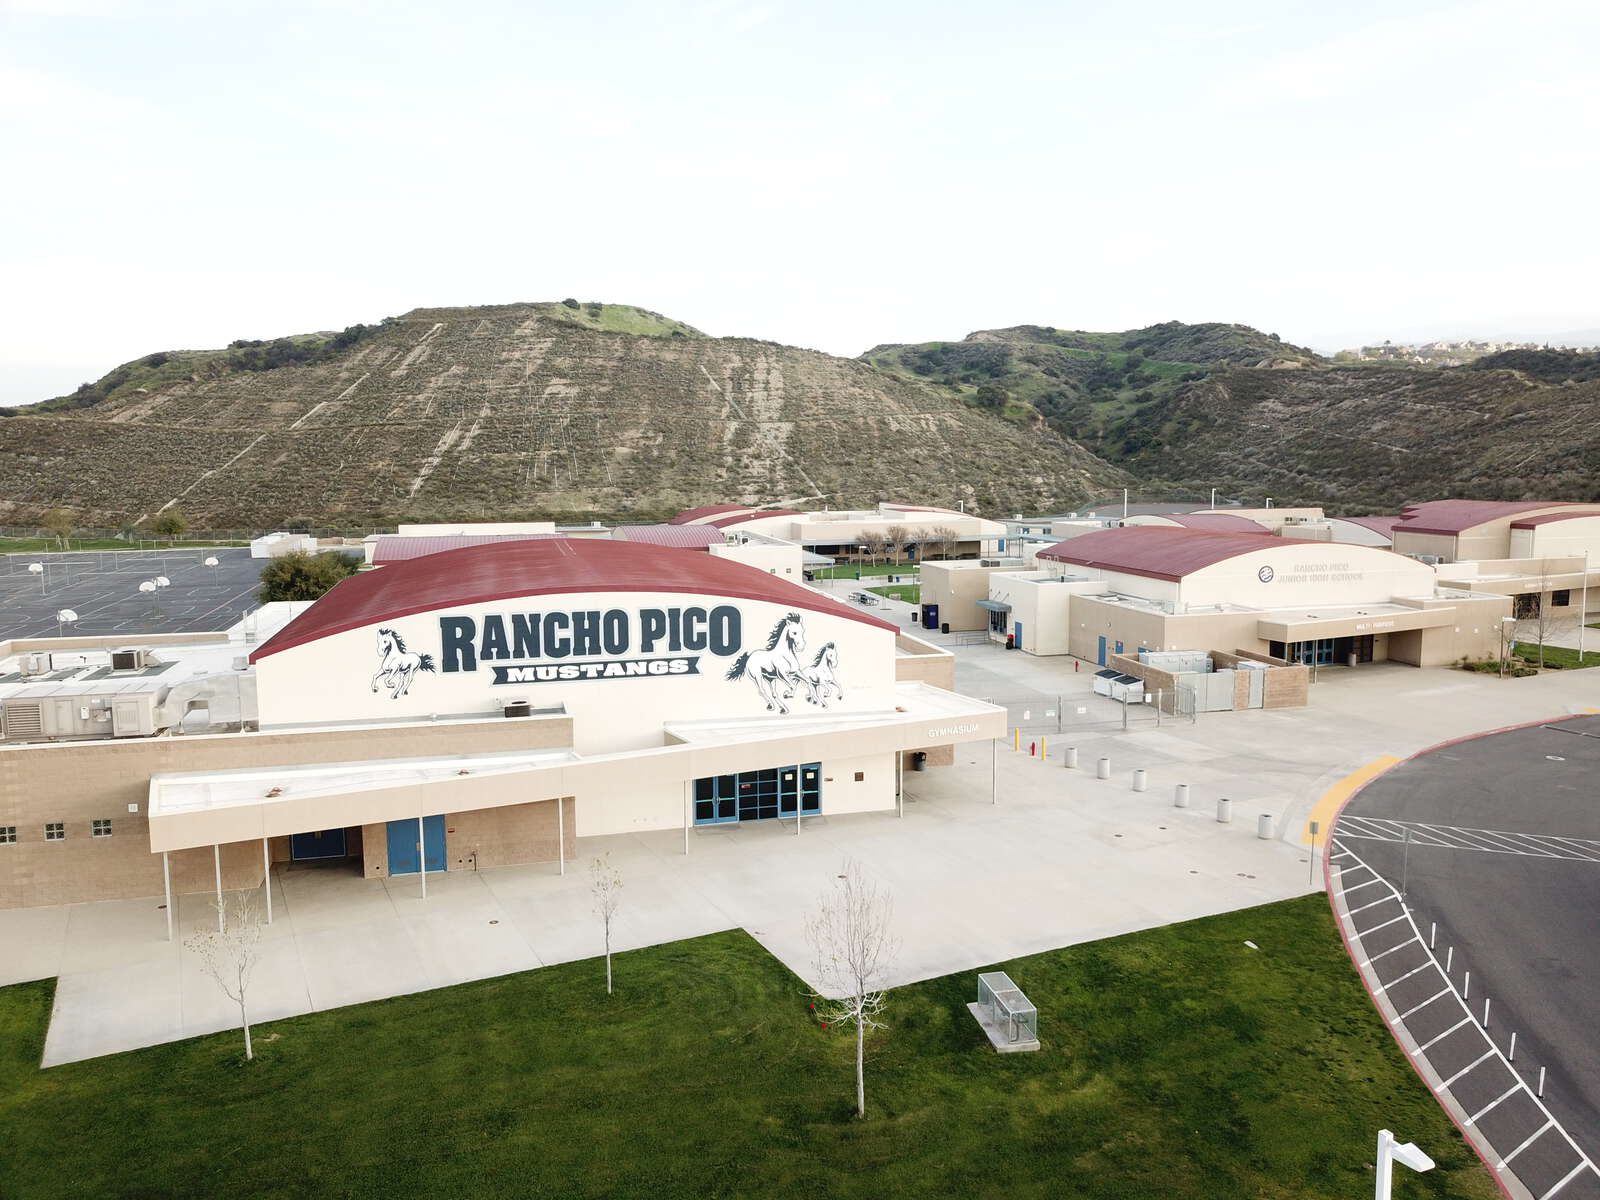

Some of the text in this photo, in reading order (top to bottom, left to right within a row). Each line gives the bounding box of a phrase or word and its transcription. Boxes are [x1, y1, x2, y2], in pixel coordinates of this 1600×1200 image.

[439, 605, 742, 673] RANCHO PICO
[506, 659, 689, 682] MUSTANGS
[928, 723, 978, 737] GYMNASIUM
